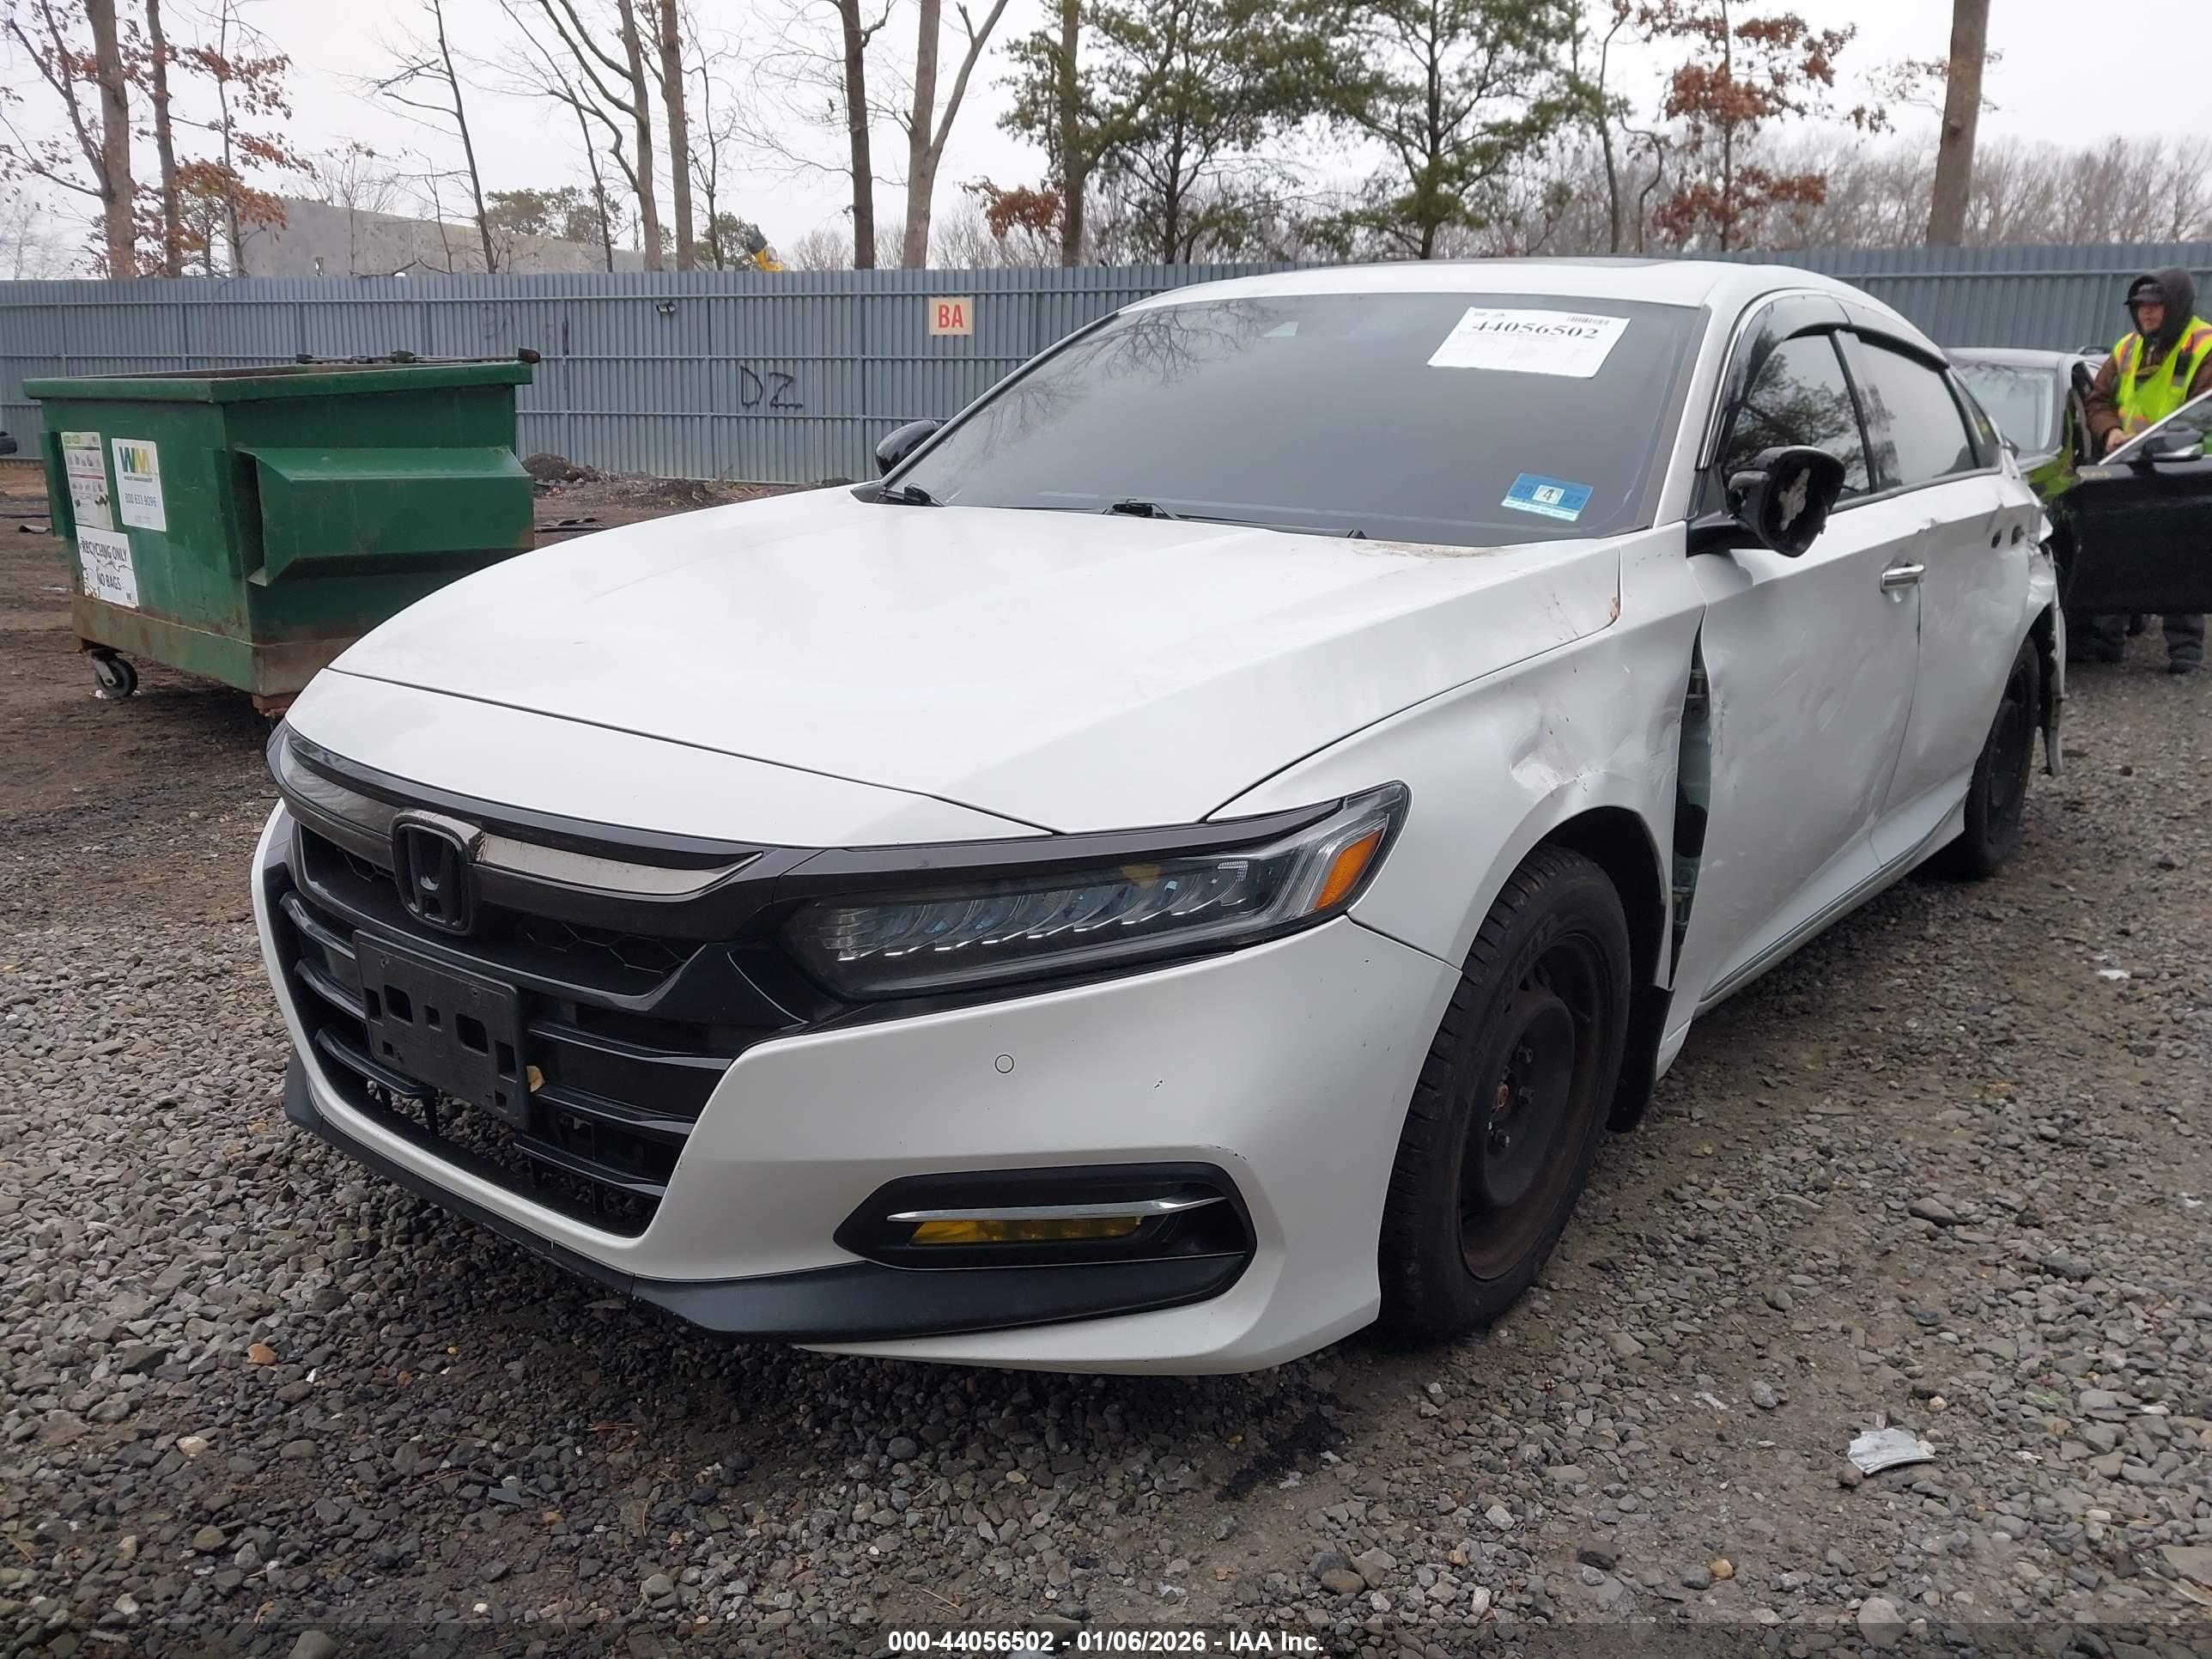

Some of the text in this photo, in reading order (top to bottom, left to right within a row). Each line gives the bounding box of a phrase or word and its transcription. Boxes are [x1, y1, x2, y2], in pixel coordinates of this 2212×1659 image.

[939, 304, 963, 328] BA
[1472, 320, 1599, 339] 44056502
[739, 365, 803, 410] DZ
[118, 446, 150, 475] WM
[1542, 488, 1555, 501] 4
[112, 546, 127, 562] ONLY
[96, 571, 122, 591] NO BAGS
